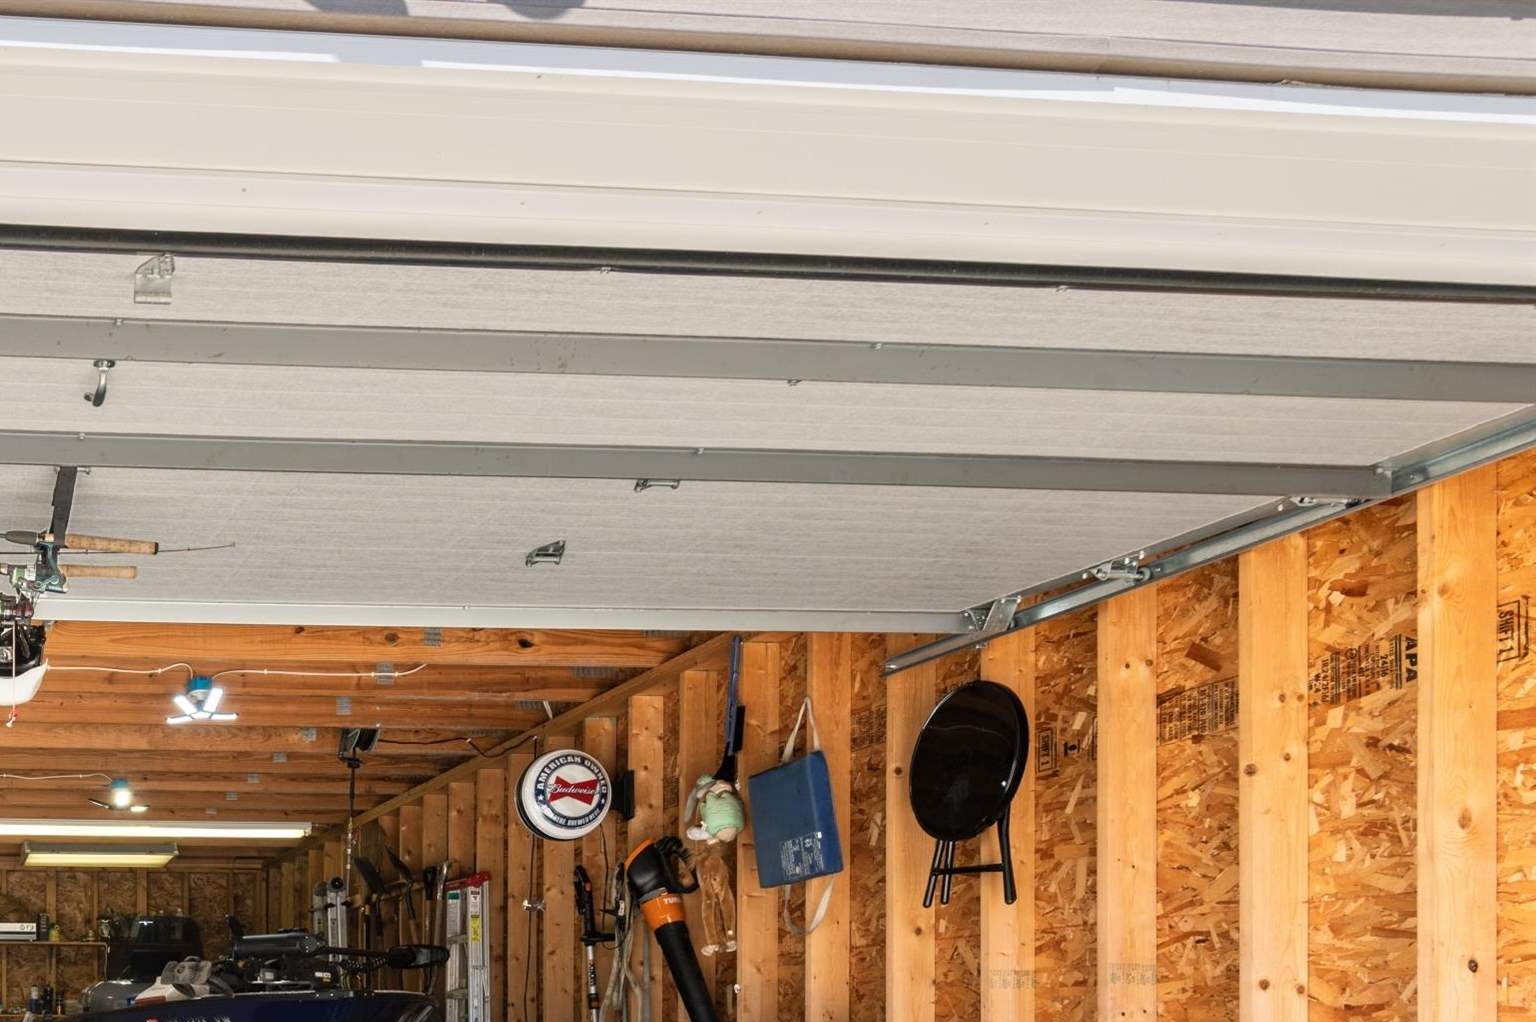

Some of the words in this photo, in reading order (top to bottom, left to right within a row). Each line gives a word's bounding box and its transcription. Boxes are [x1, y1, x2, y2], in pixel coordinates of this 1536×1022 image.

[1405, 636, 1418, 682] APA
[537, 755, 582, 790] AMERICAN
[584, 760, 607, 793] OWNED
